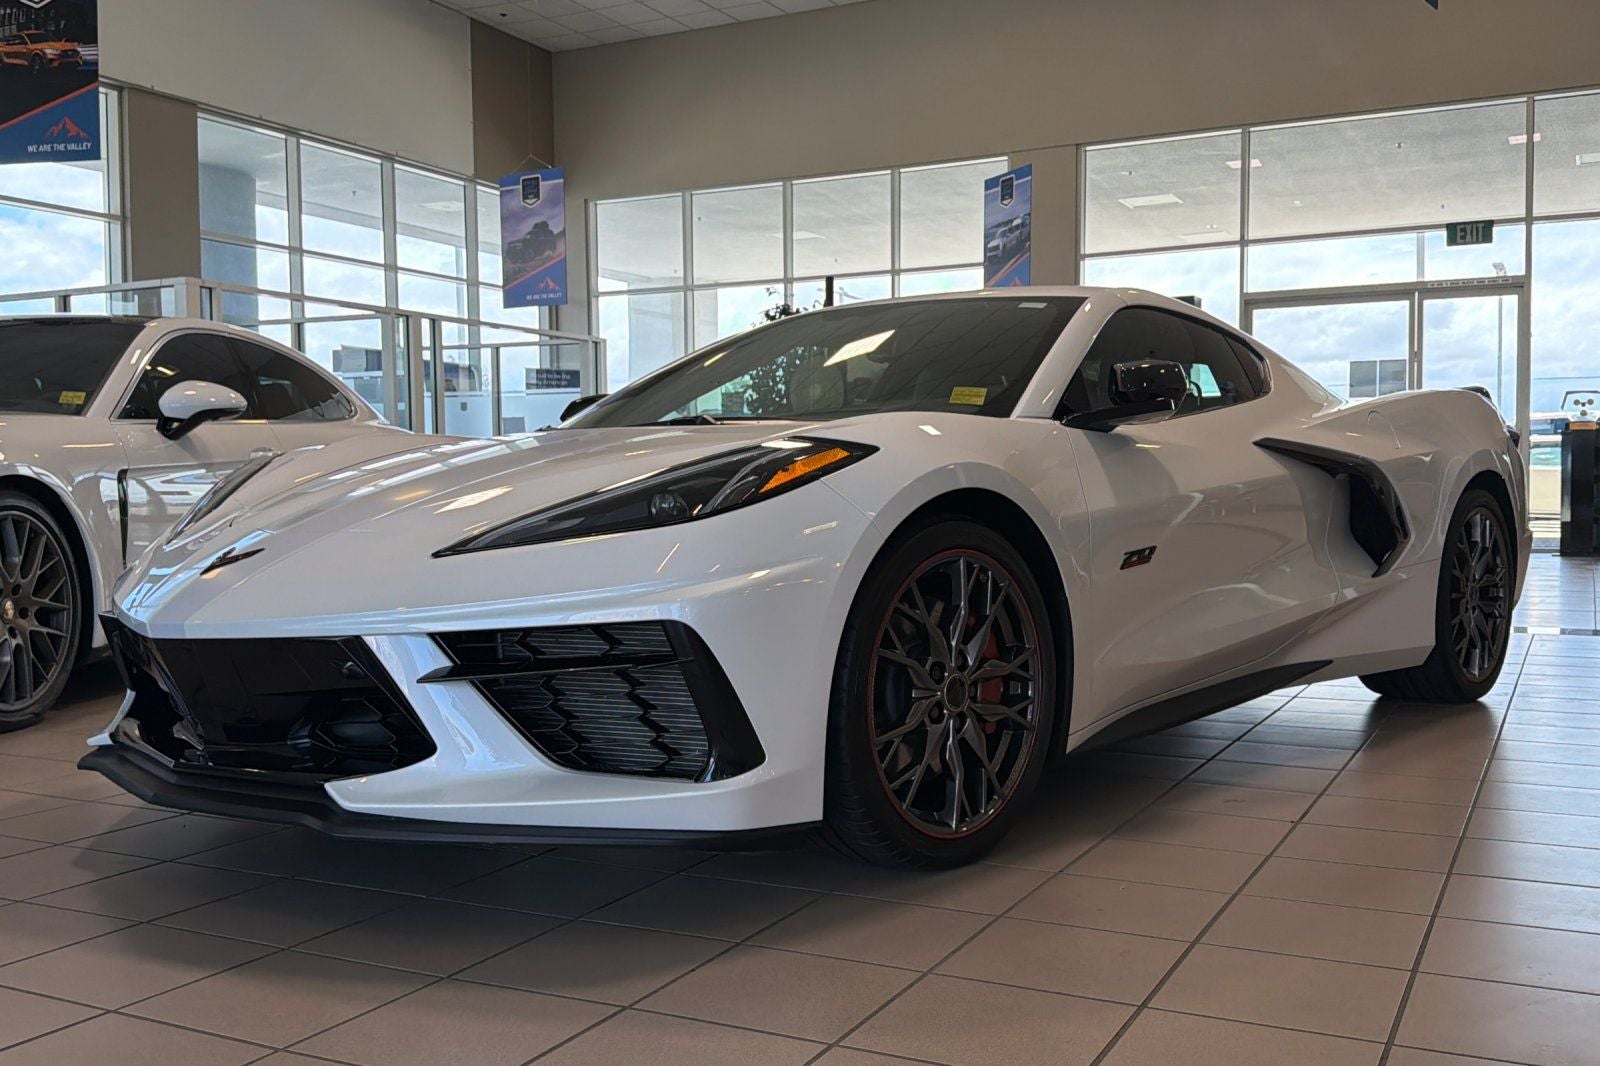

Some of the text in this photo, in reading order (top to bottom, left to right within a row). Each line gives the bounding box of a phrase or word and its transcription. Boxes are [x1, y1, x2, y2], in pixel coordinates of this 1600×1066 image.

[28, 142, 92, 153] WE ARE THE VALLEY
[1456, 223, 1484, 243] EXIT
